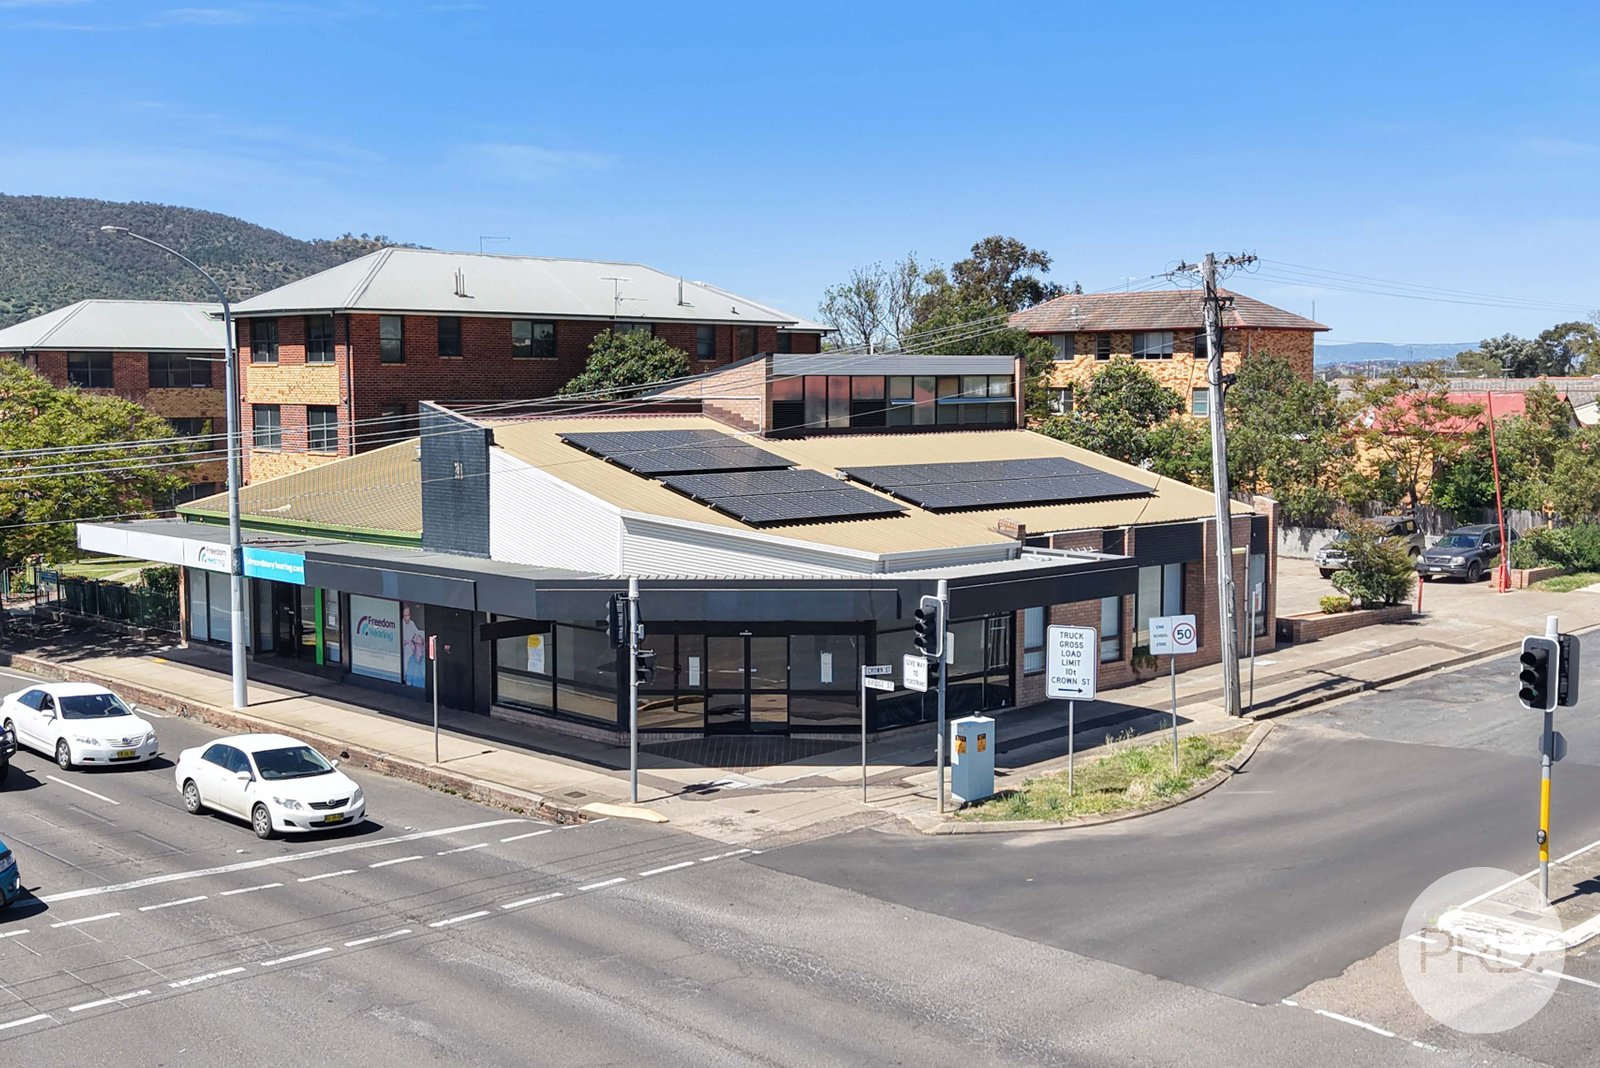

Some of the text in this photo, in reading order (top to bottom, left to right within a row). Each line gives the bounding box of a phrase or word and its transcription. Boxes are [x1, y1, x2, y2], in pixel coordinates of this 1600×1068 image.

[368, 616, 396, 629] Freedom
[368, 628, 394, 642] Hearing
[1177, 628, 1192, 640] 50
[1061, 650, 1082, 658] LOAD
[1065, 668, 1077, 676] 10t
[867, 679, 885, 687] BRIDGE
[1051, 676, 1078, 685] CROWN
